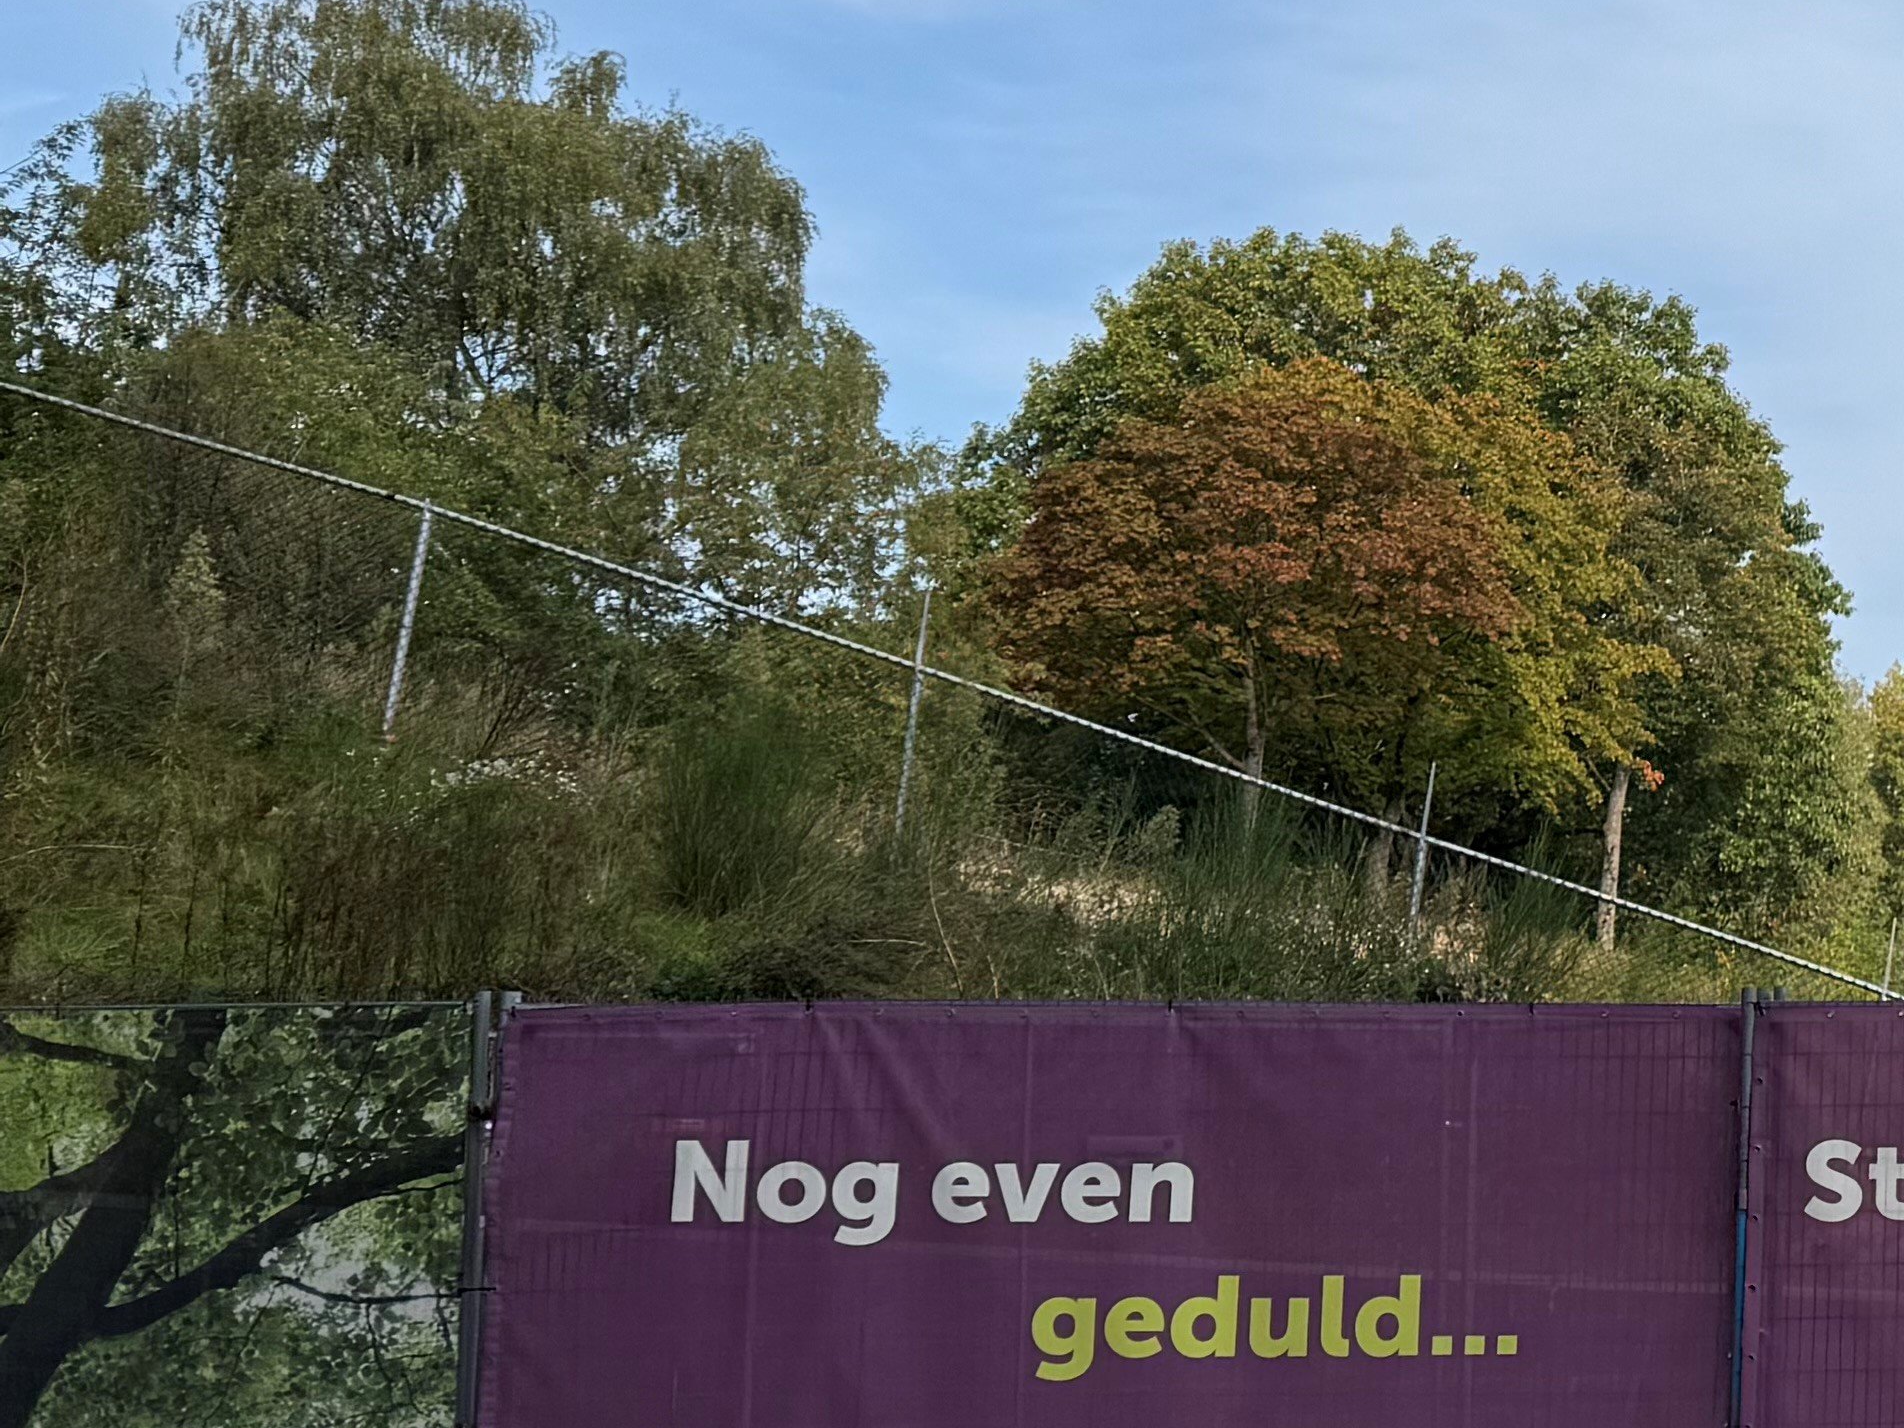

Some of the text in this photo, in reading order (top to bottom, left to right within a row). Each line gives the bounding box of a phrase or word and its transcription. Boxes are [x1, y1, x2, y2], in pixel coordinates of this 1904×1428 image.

[671, 1140, 1195, 1247] Nog even
[1032, 1275, 1518, 1382] geduld...
